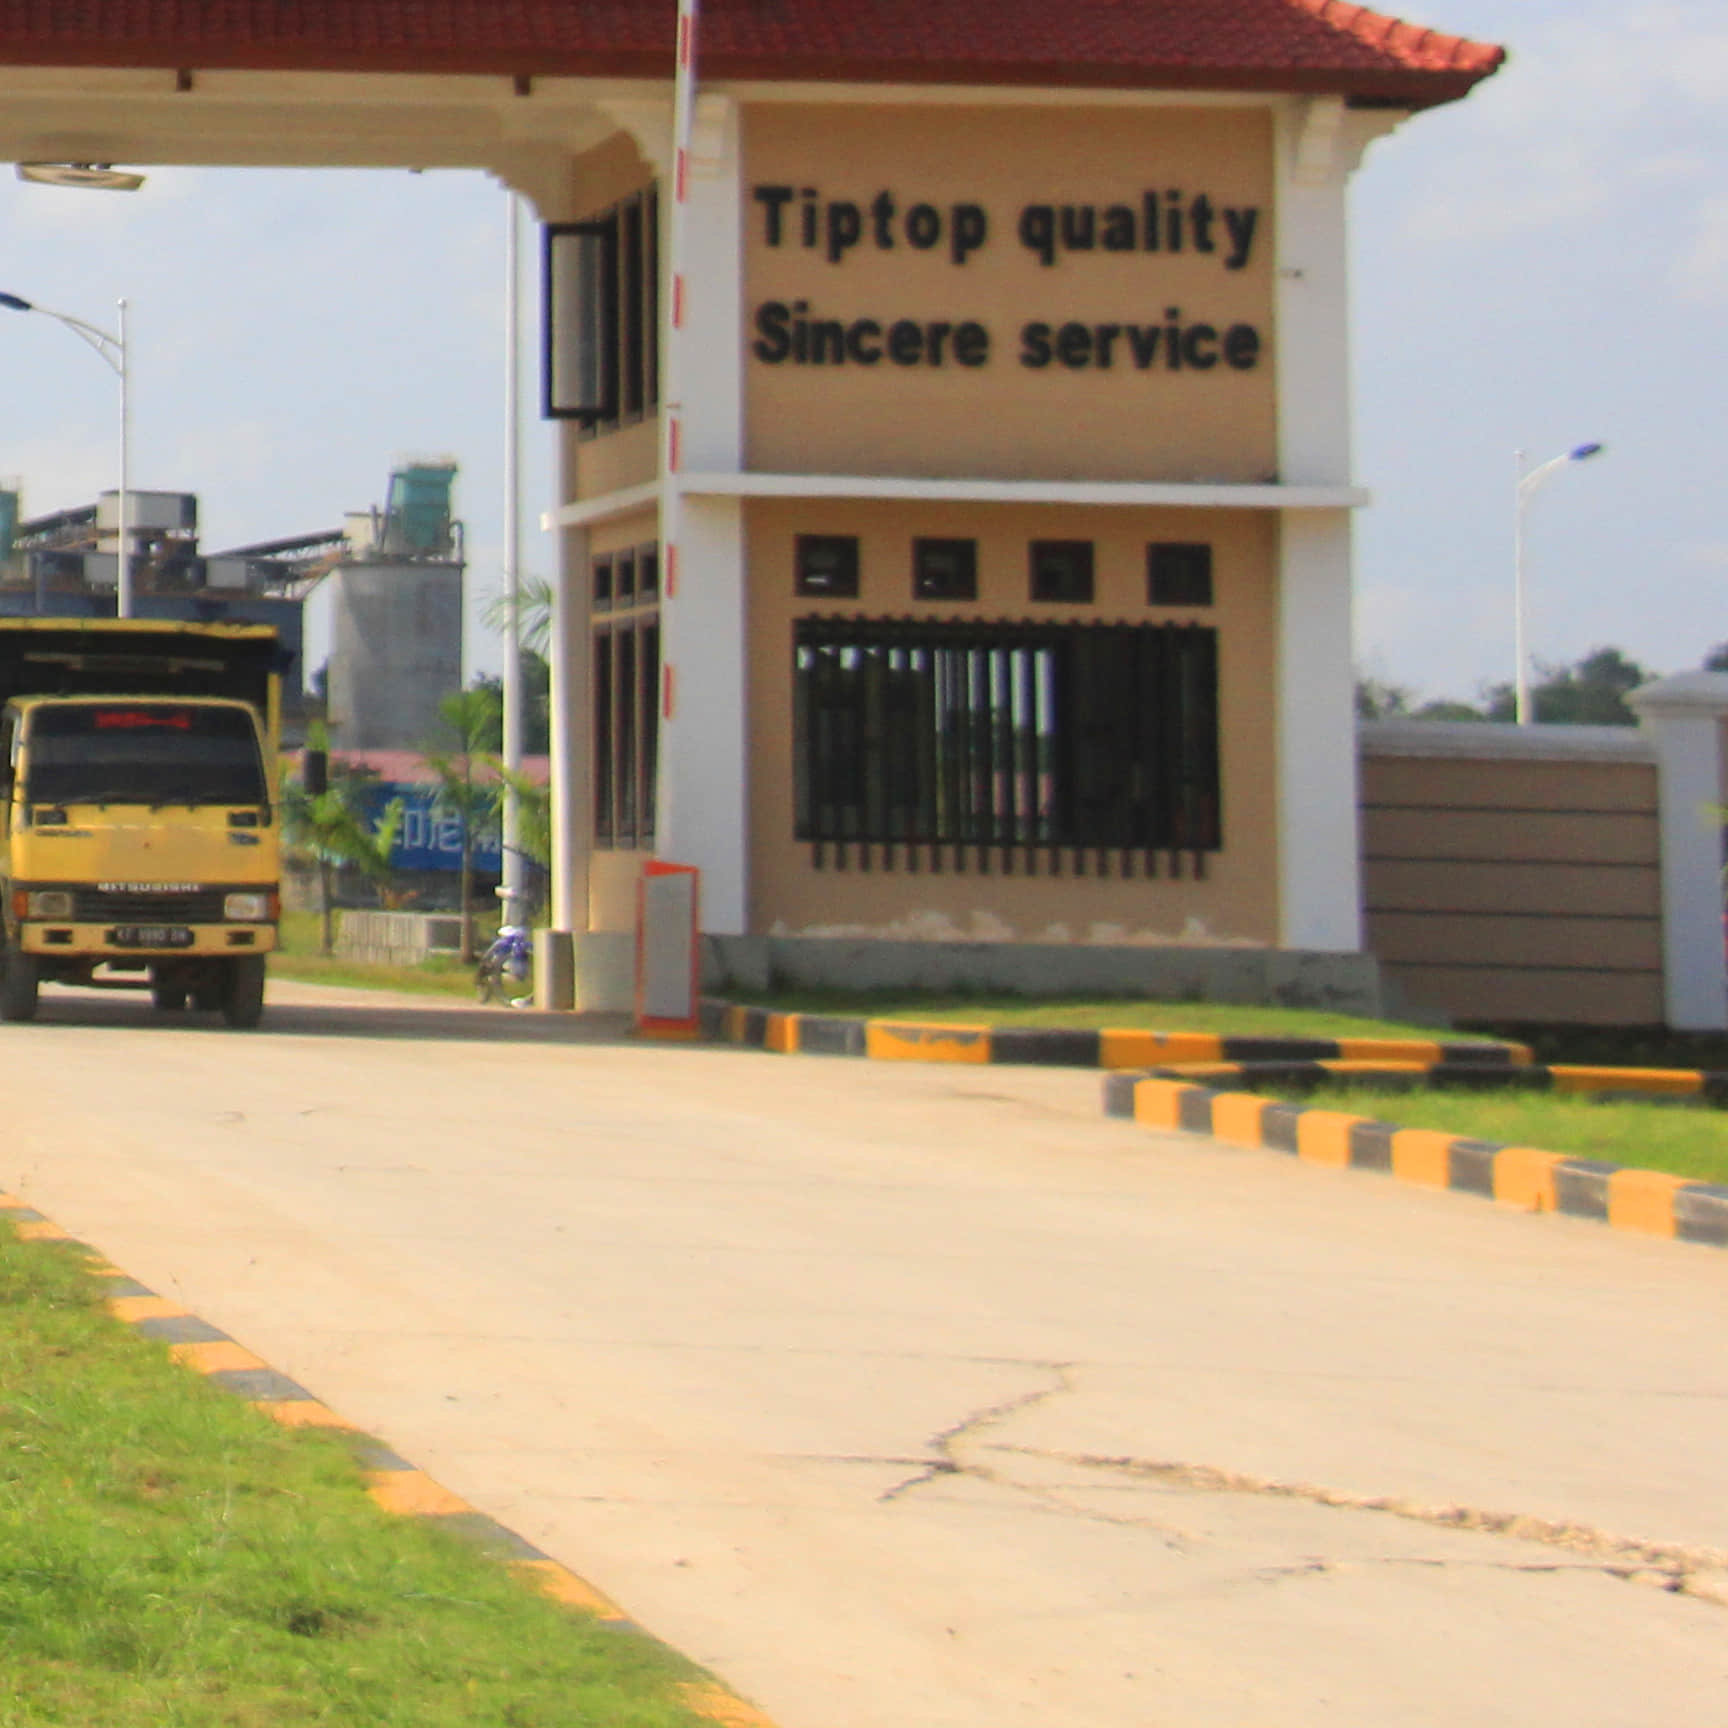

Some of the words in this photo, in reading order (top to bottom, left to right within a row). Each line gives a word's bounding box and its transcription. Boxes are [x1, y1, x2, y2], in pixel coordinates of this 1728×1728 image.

[754, 185, 988, 265] Tiptop
[1018, 190, 1258, 270] quality
[752, 300, 989, 366] Sincere
[1019, 308, 1260, 370] service
